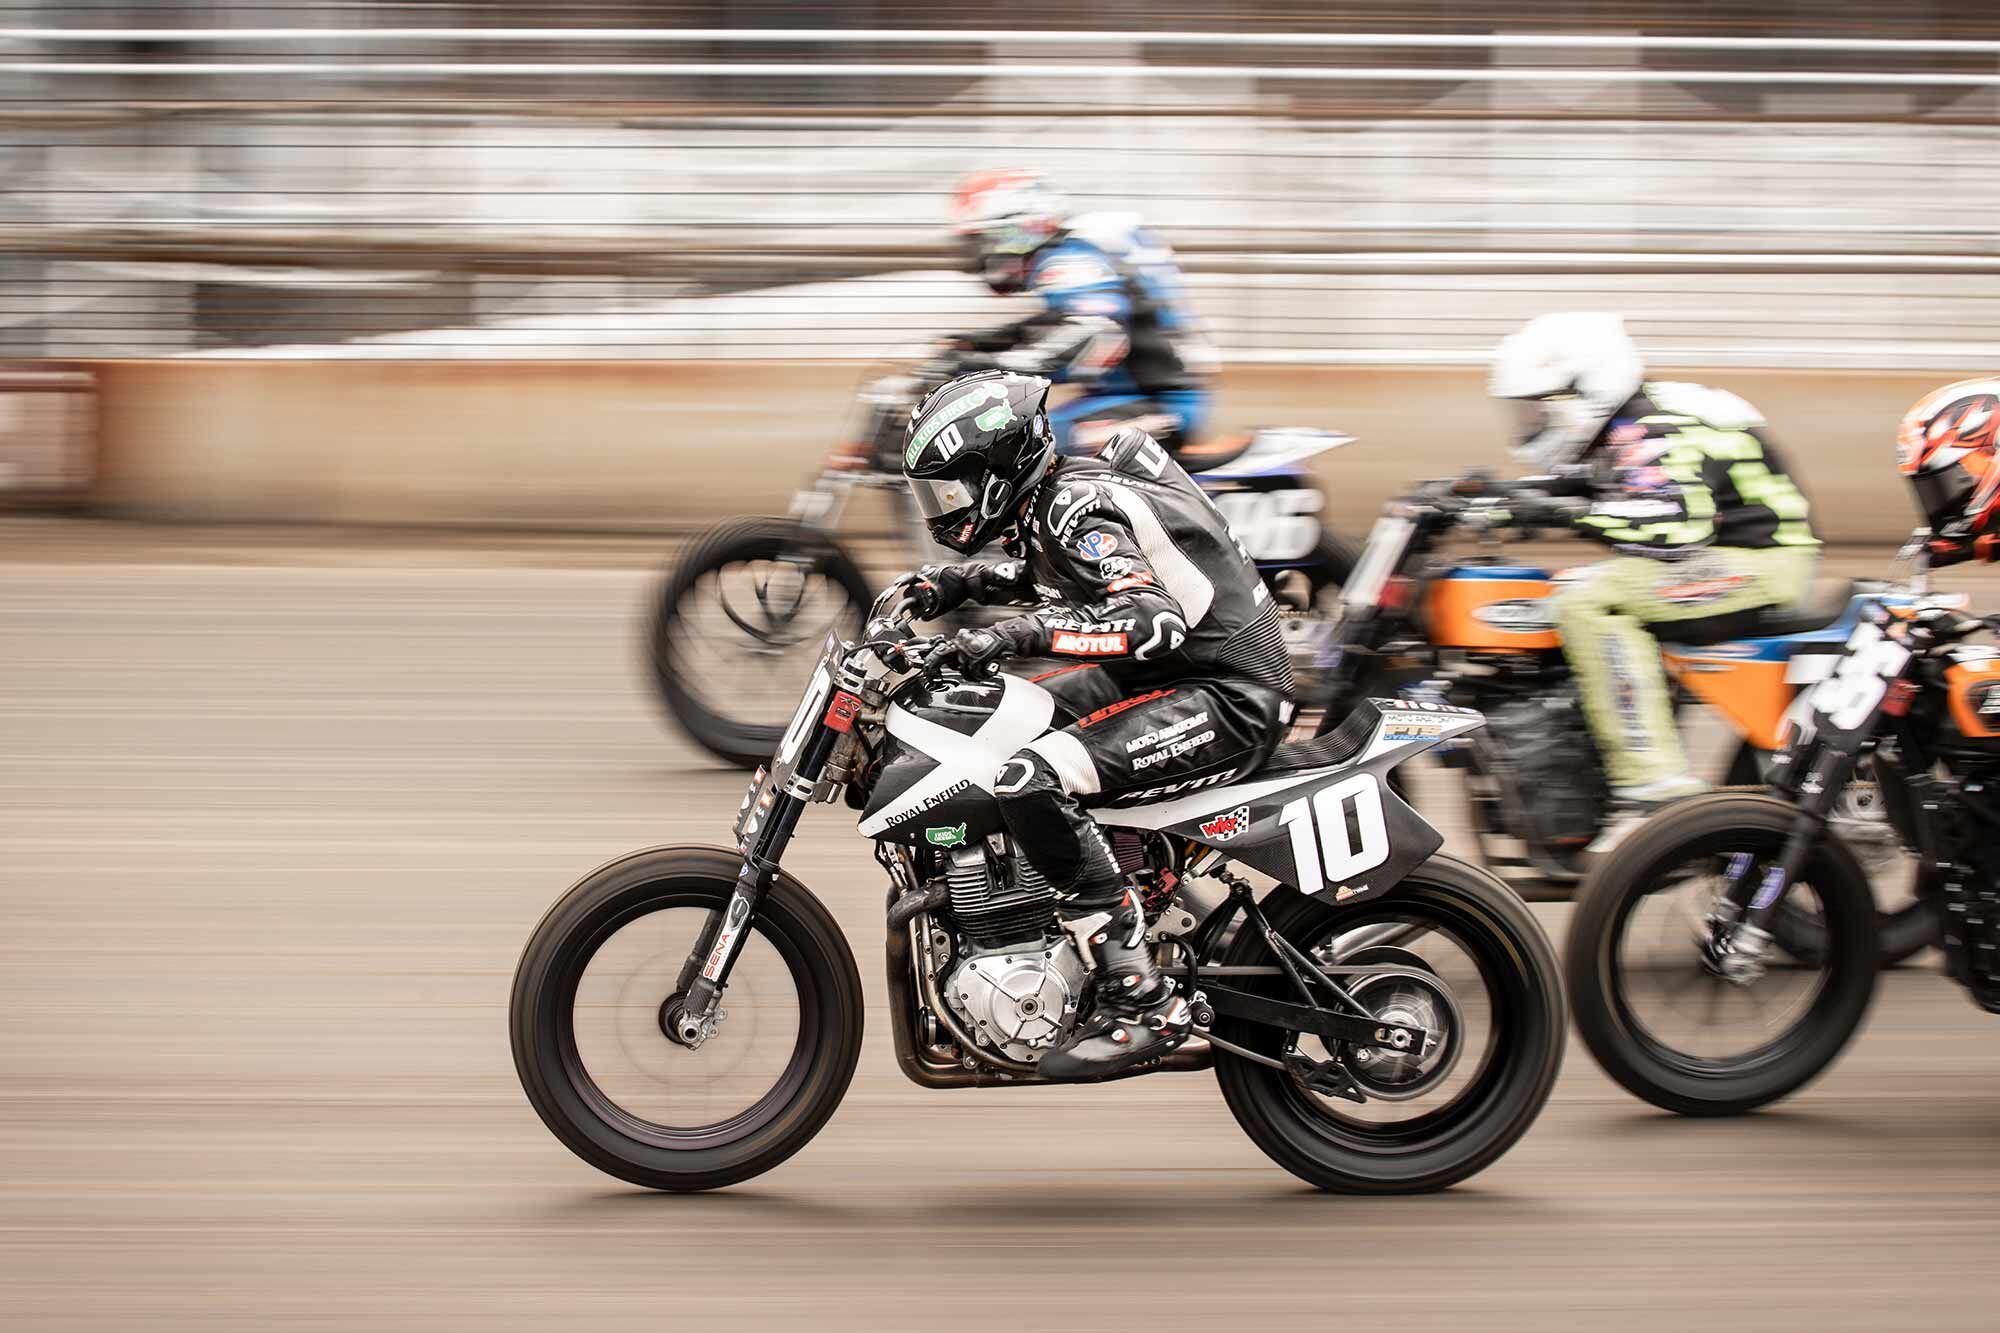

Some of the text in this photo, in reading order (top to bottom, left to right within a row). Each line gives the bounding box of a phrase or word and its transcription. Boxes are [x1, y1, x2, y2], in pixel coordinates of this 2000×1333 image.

[908, 443, 921, 464] ALL
[919, 420, 942, 444] KIDS
[934, 423, 964, 462] 10
[1077, 530, 1103, 560] VP
[1055, 633, 1124, 653] MOTUL
[1126, 731, 1159, 754] MOTO
[1158, 711, 1209, 741] ANATOMY
[1132, 749, 1171, 771] ROYAL
[1170, 730, 1216, 758] ENFIELD
[884, 779, 971, 828] ROYAL ENFIELD
[1278, 773, 1390, 895] 10
[704, 933, 731, 978] SENA
